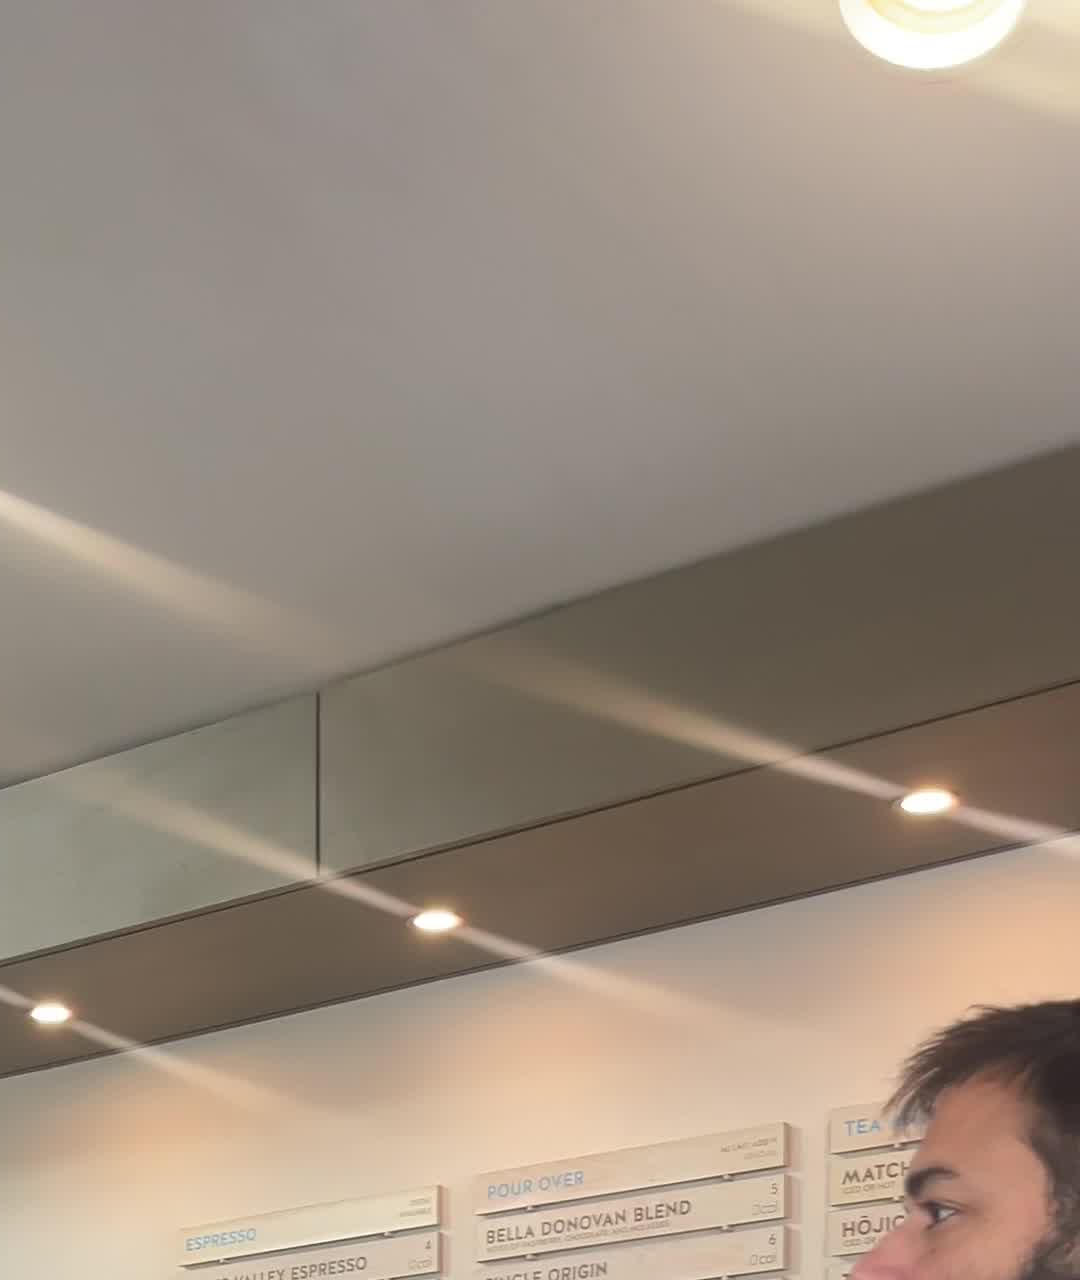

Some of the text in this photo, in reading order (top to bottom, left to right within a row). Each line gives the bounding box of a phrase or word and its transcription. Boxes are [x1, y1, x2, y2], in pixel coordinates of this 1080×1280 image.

[843, 1118, 881, 1137] TEA
[487, 1170, 585, 1200] POUR OVER
[841, 1160, 911, 1185] MATCH
[486, 1224, 535, 1245] BELLA
[541, 1209, 627, 1237] DONOVAN
[633, 1199, 692, 1223] BLEND
[184, 1227, 257, 1252] ESPRESSO
[768, 1233, 777, 1246] 6
[291, 1256, 368, 1280] ESPRESSO
